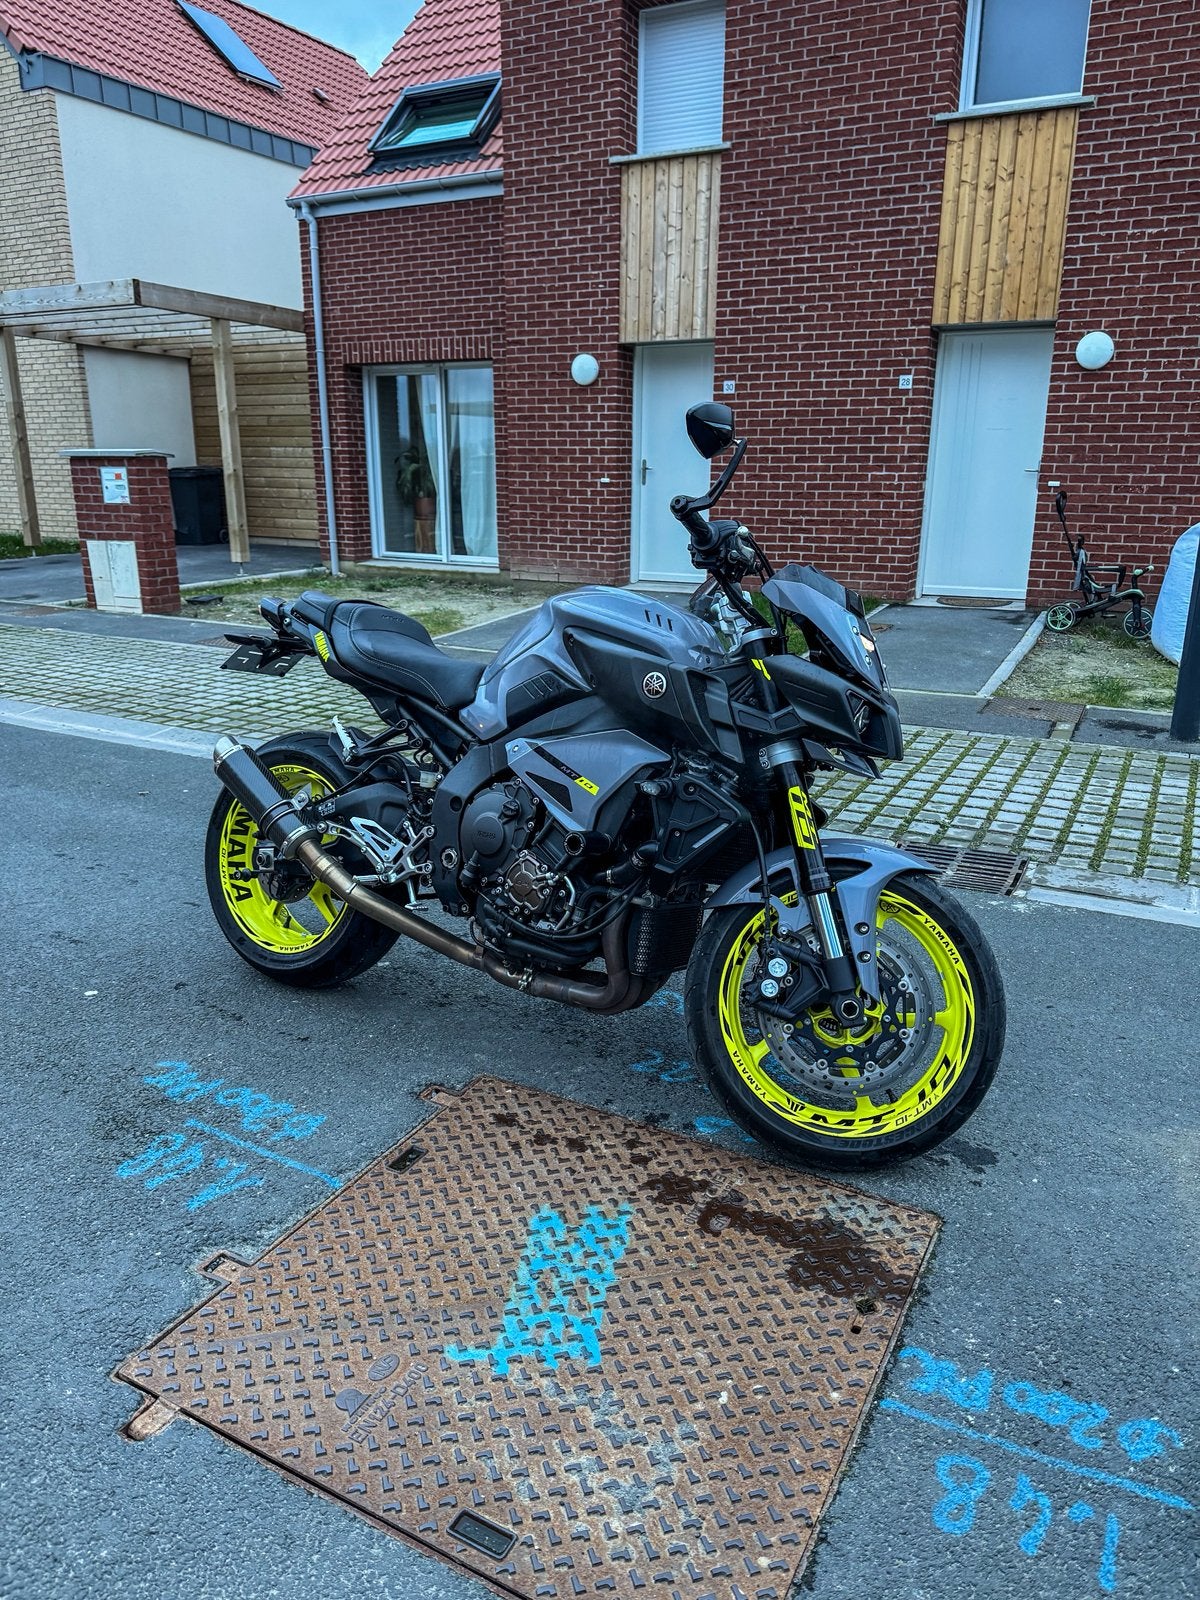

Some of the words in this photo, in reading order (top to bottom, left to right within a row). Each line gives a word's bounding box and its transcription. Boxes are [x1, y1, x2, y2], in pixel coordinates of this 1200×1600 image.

[725, 383, 734, 391] 30
[901, 377, 911, 387] 28
[314, 630, 330, 663] YAMAHA
[227, 805, 254, 902] MAHA
[279, 942, 310, 951] YAMAHA
[923, 916, 961, 965] YAMAHA
[732, 1049, 768, 1099] YAMAHA
